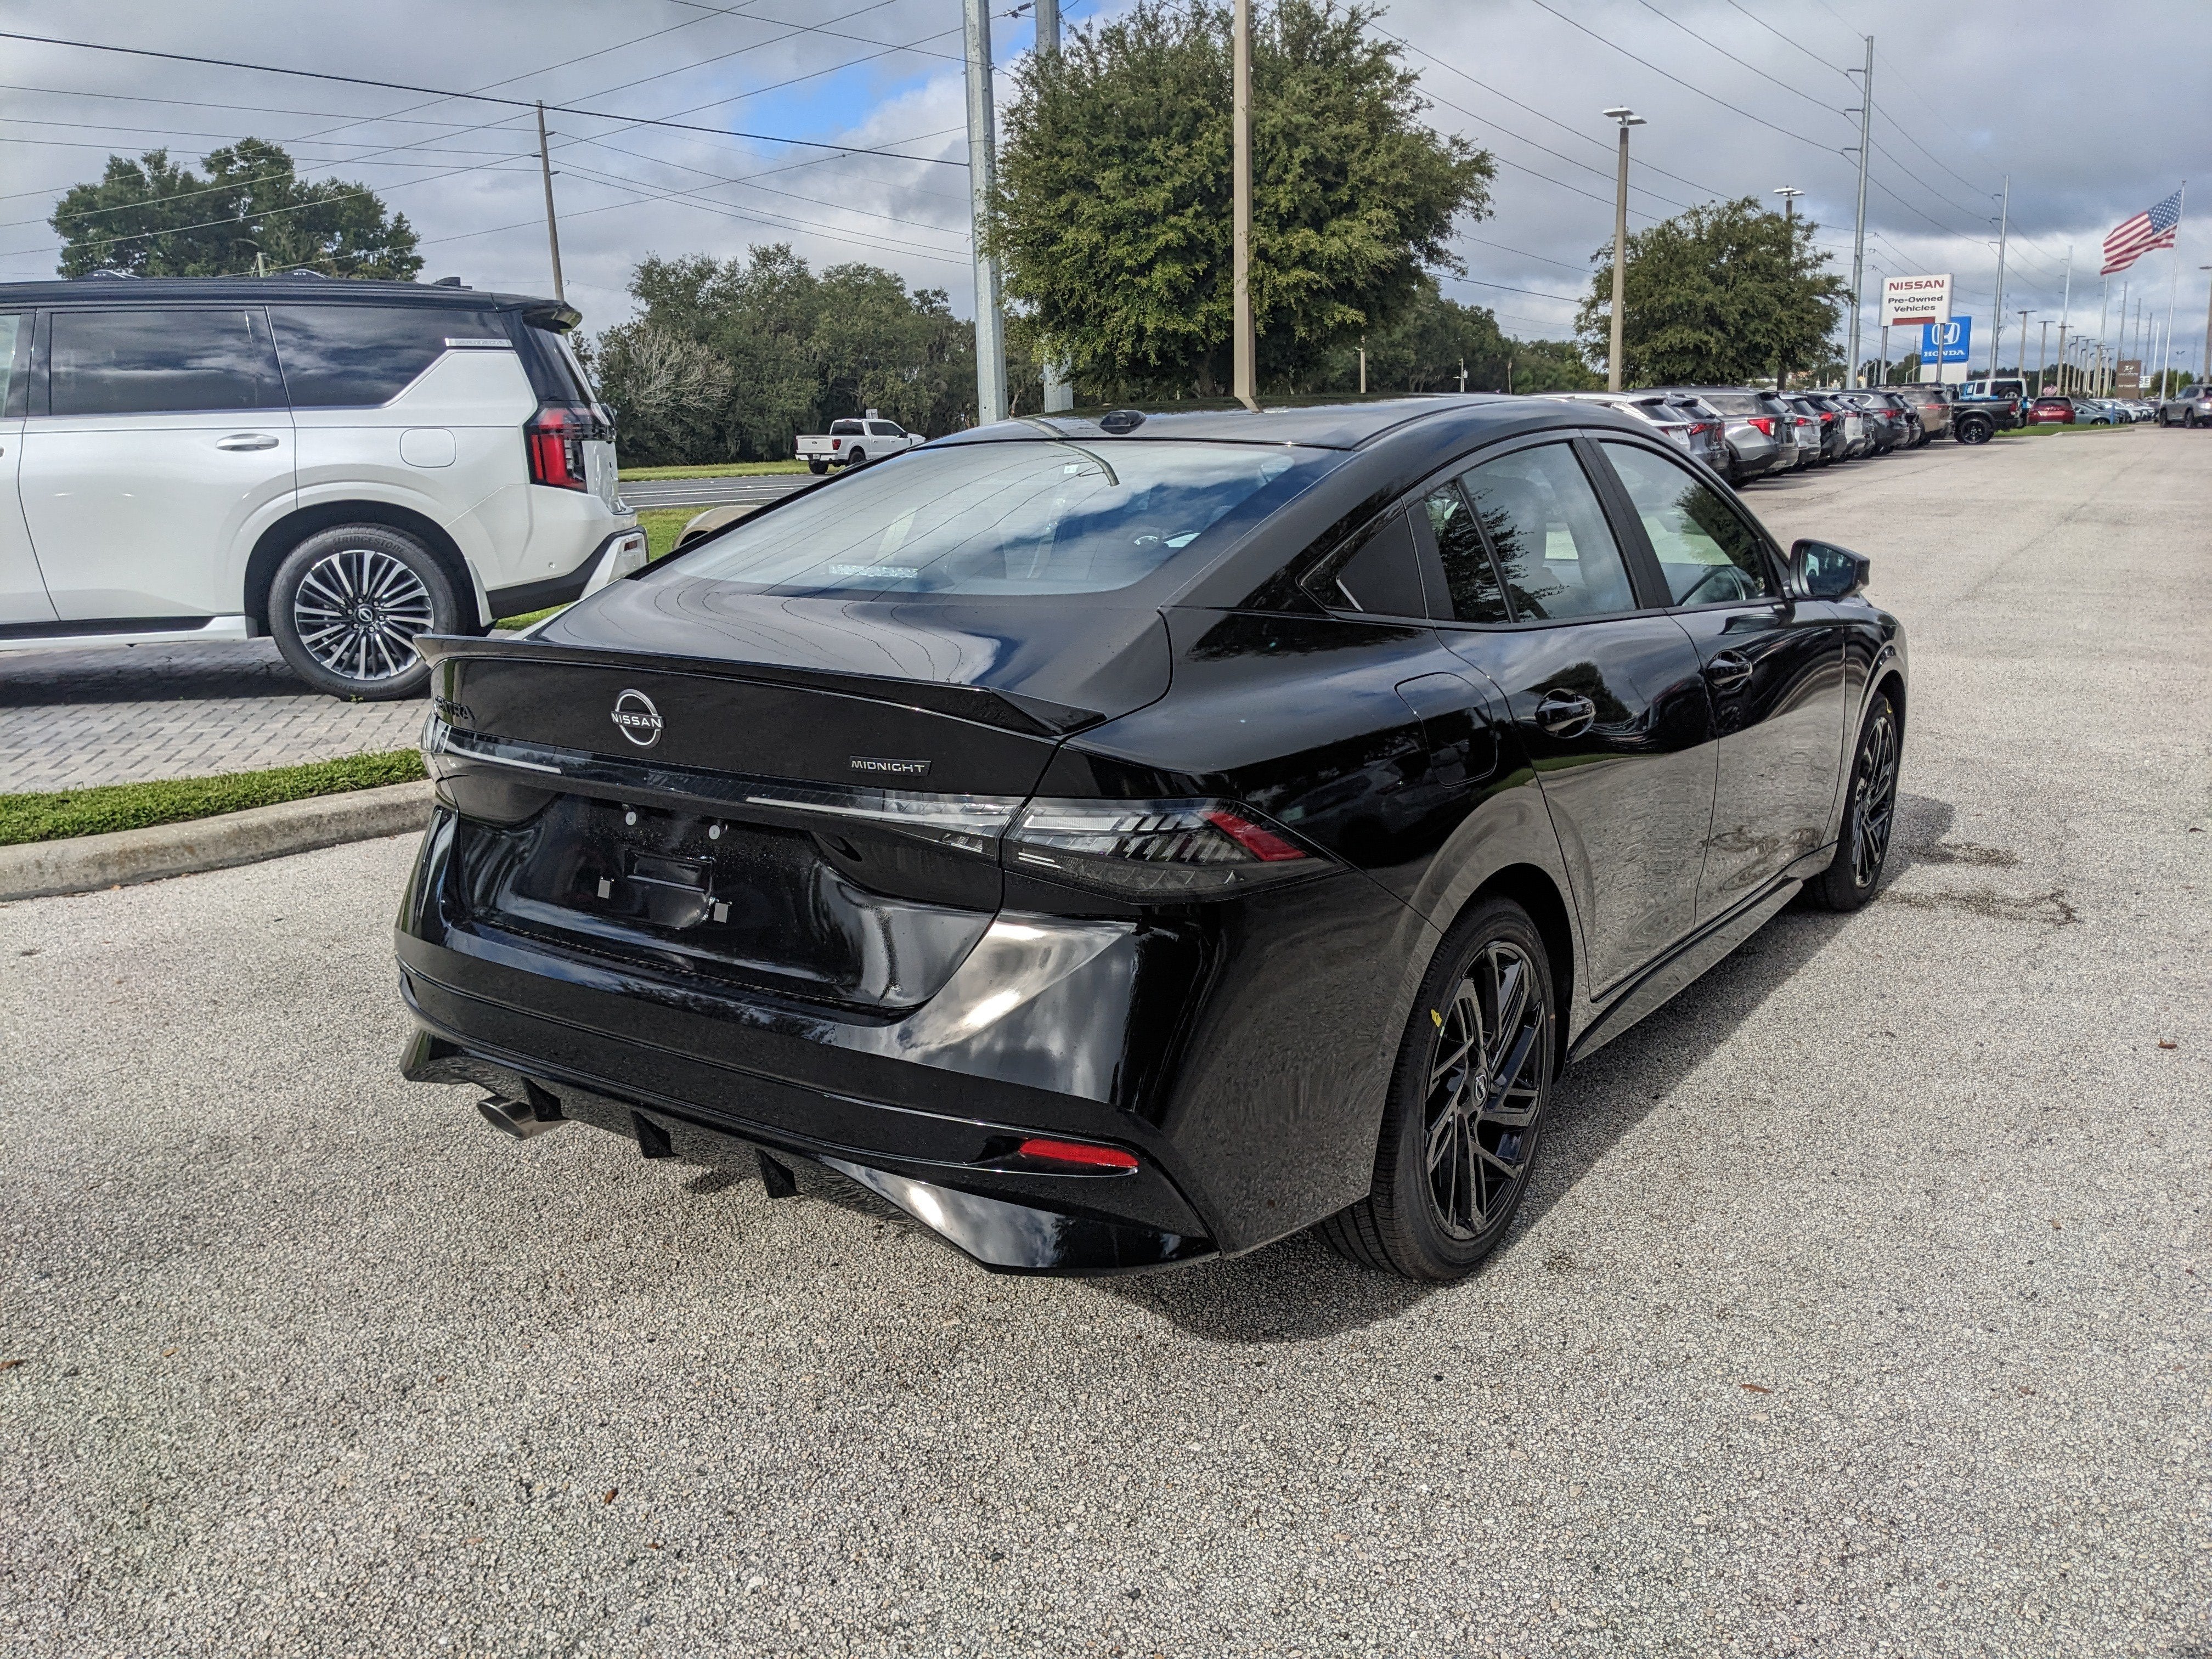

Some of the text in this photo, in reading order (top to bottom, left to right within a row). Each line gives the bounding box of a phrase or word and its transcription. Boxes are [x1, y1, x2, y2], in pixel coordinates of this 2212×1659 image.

[1889, 280, 1944, 291] NISSAN
[1888, 295, 1943, 303] Pre-Owned
[611, 713, 662, 727] NISSAN
[851, 760, 925, 773] MIDNIGHT
